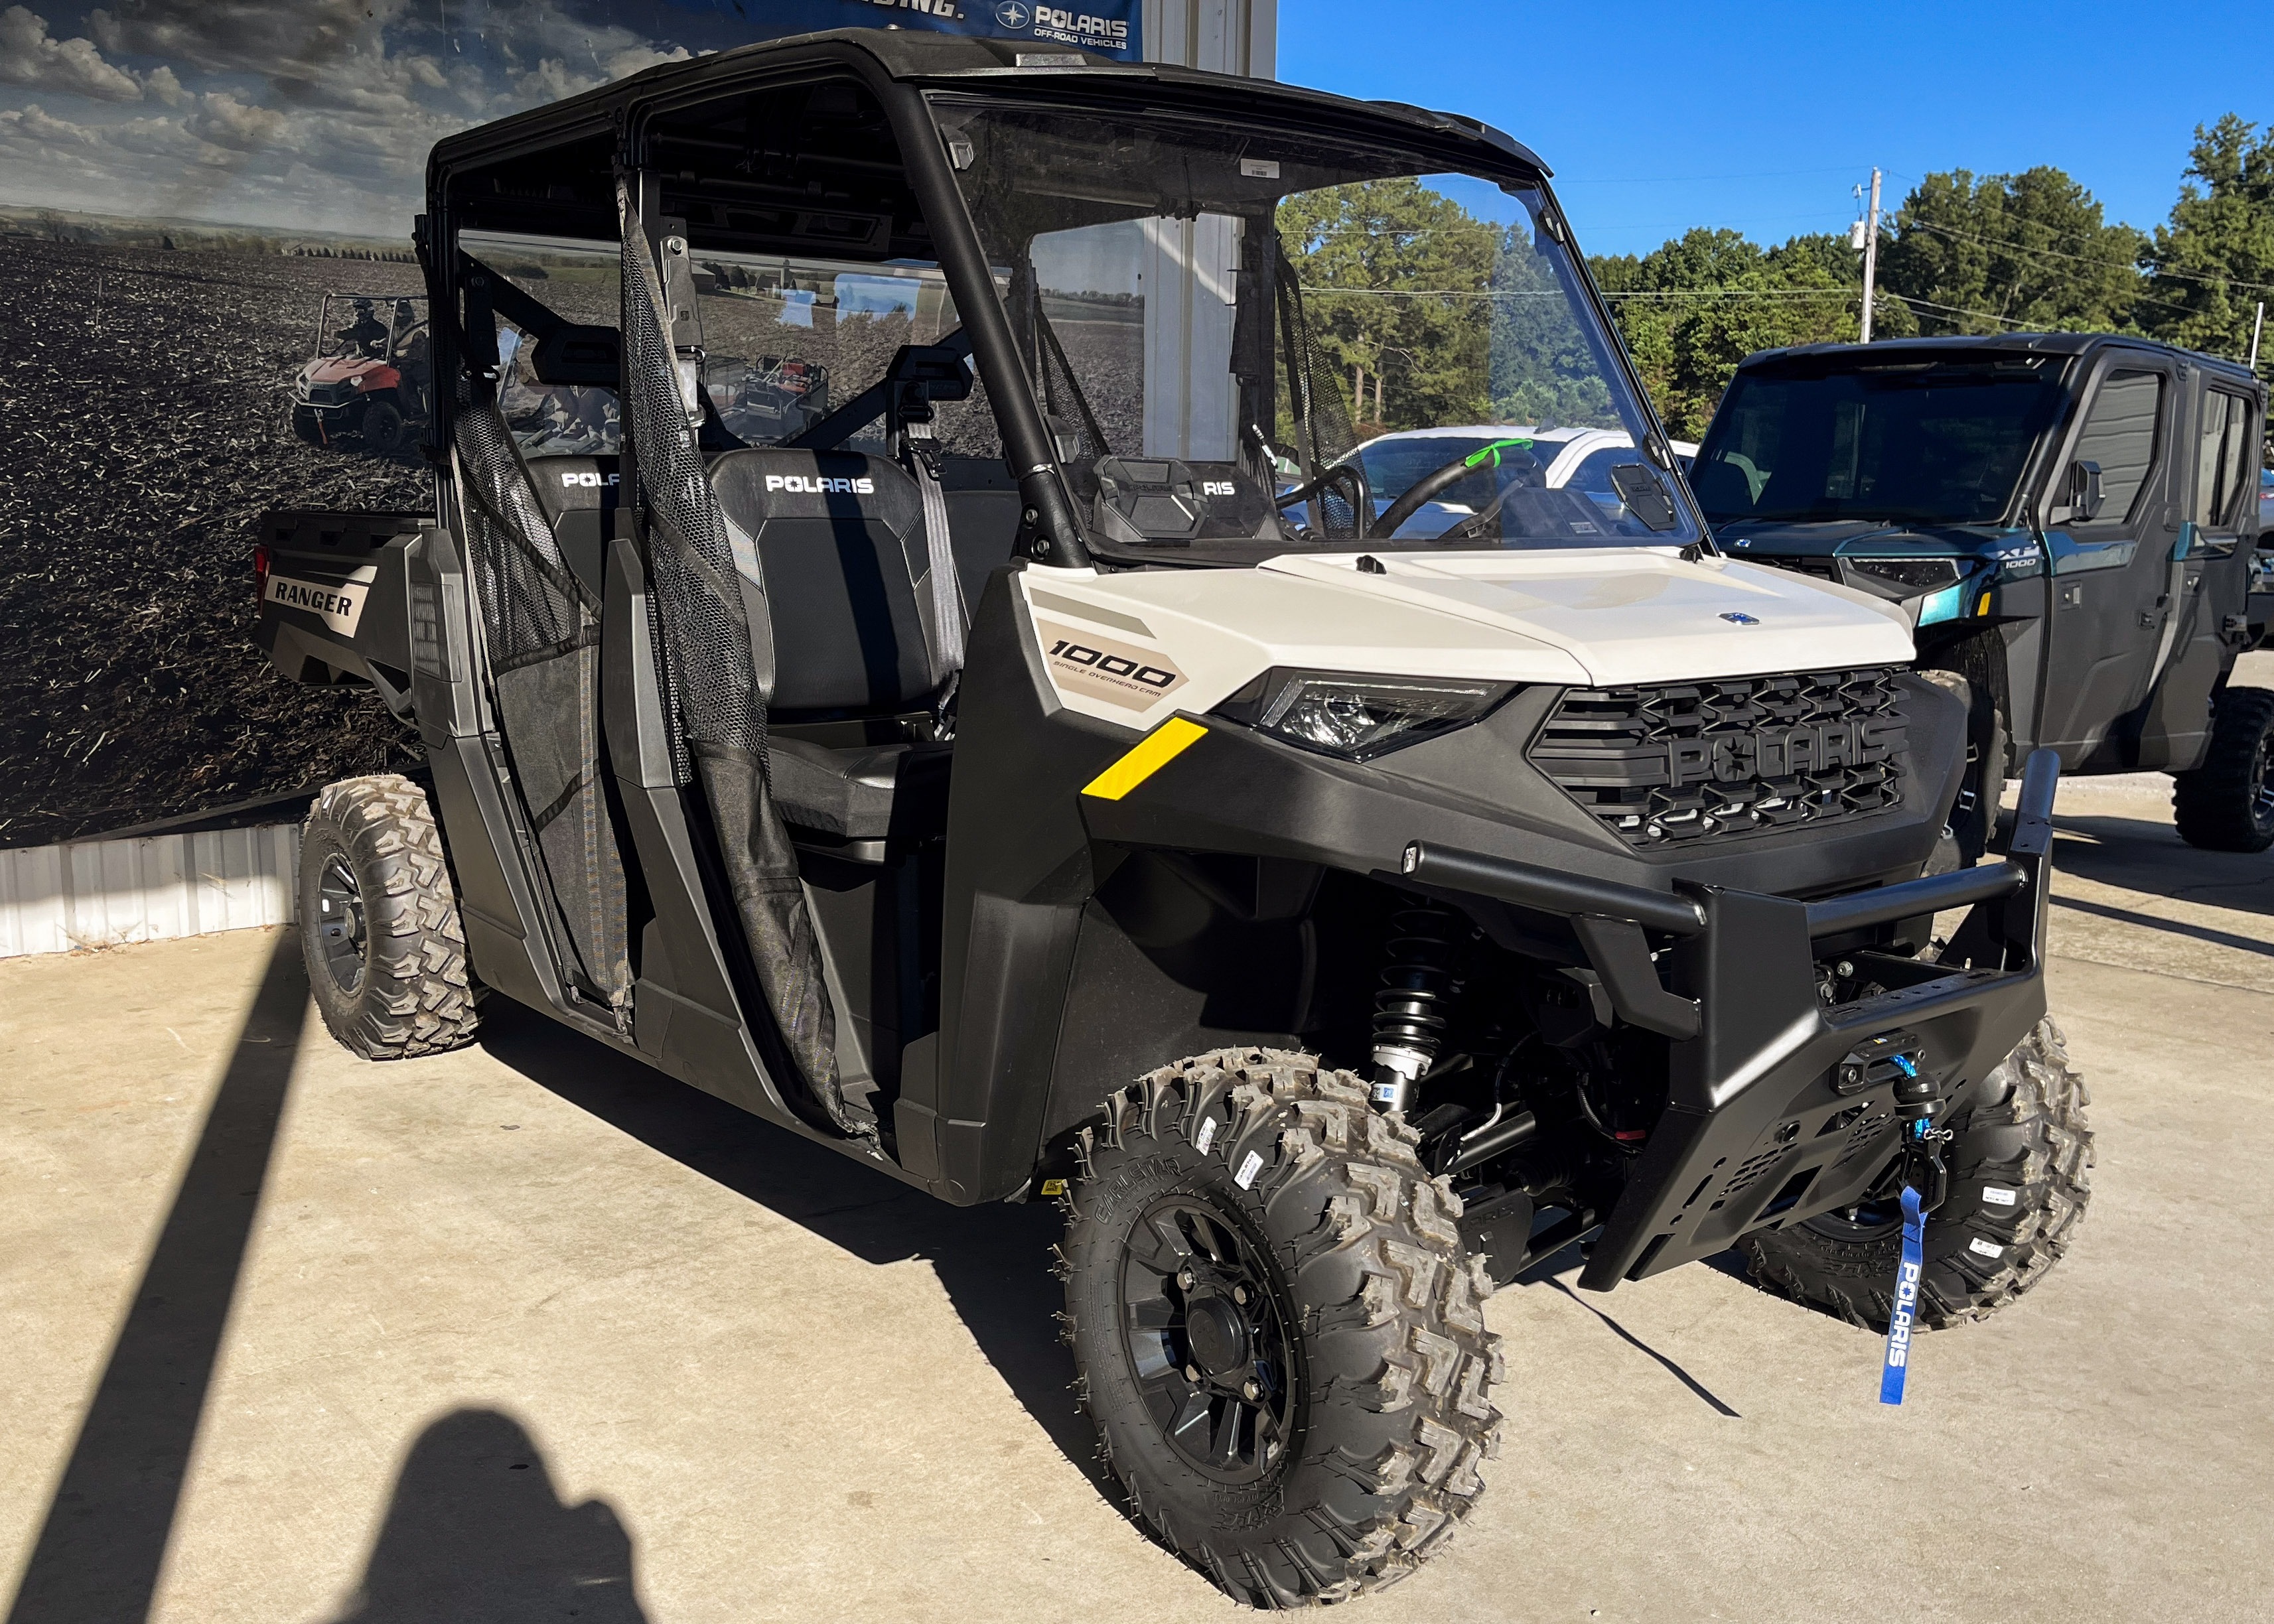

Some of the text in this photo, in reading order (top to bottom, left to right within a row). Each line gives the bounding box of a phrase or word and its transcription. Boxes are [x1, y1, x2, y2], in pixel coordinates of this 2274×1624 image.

[1034, 28, 1127, 50] OFF-ROAD VEHICLES
[1035, 5, 1127, 38] POLARIS
[765, 474, 875, 494] POLARIS
[2006, 558, 2036, 569] 1000
[275, 581, 352, 616] RANGER
[1048, 640, 1176, 688] 1000
[1053, 661, 1161, 697] SINGLE OVERHEAD CAM
[1668, 718, 1891, 788] POLARIS
[1888, 1262, 1920, 1367] POLARIS
